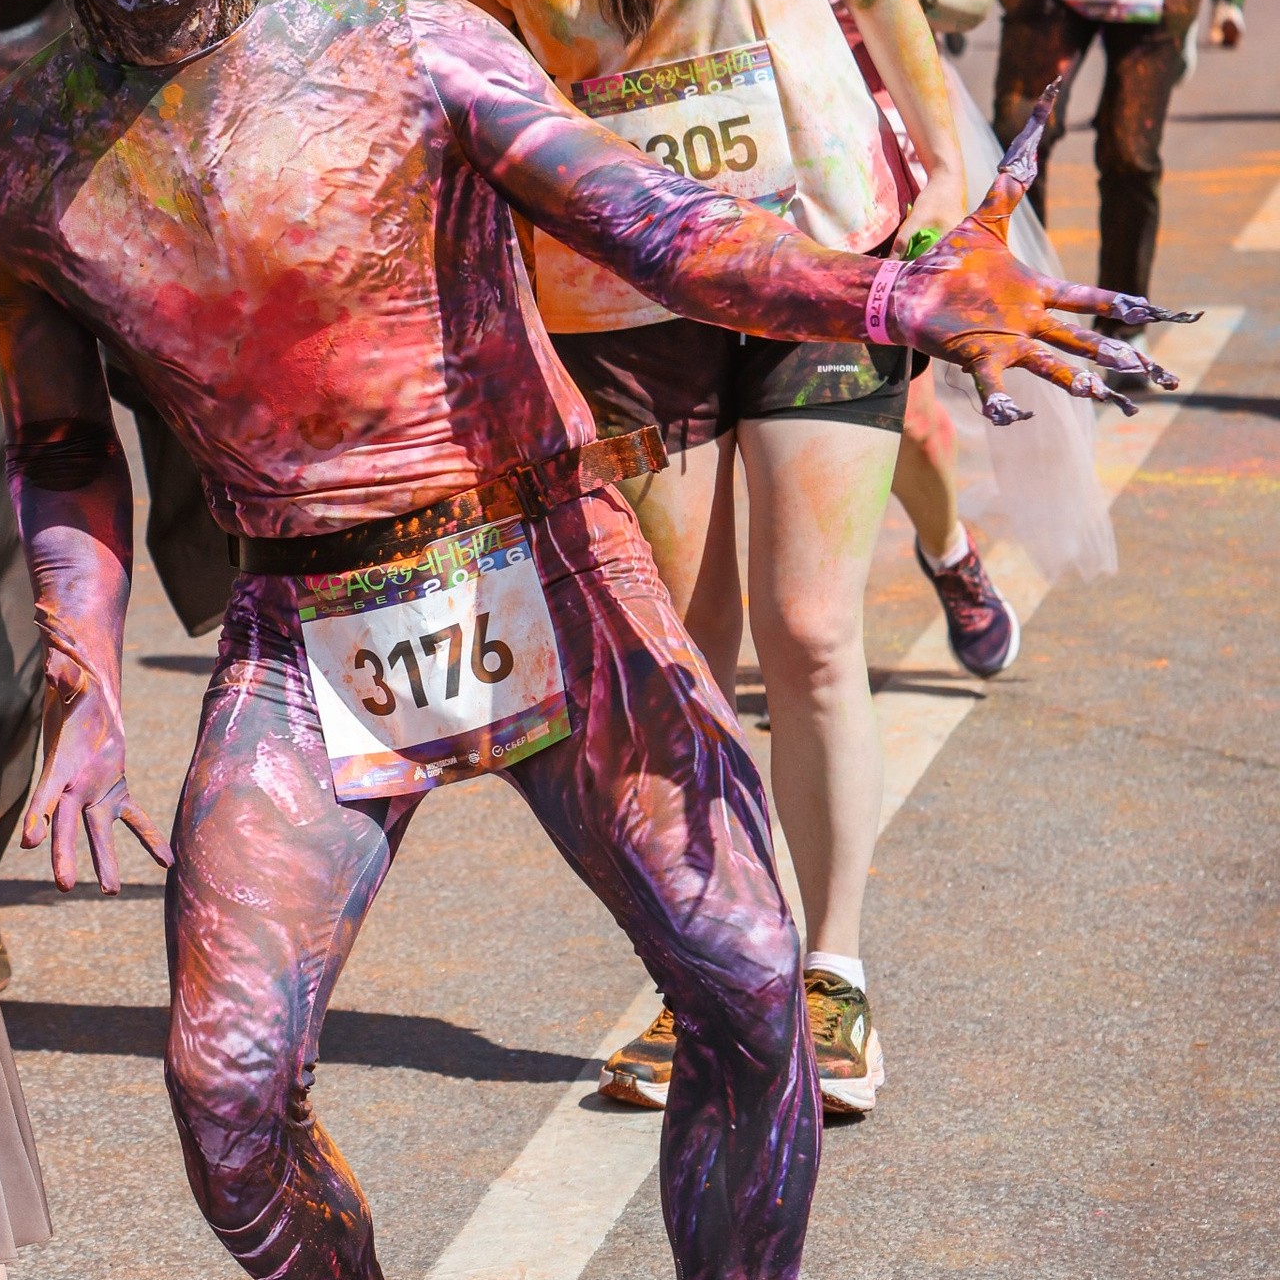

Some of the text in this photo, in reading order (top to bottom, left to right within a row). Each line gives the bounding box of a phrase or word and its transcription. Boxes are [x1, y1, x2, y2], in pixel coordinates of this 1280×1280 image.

[684, 70, 769, 100] 2026
[628, 115, 758, 180] 305
[870, 282, 887, 327] 3176
[817, 364, 859, 373] EUPHORIA
[322, 546, 525, 614] ЗАБЕГ 2026
[354, 612, 514, 716] 3176
[505, 736, 526, 751] СБЕР
